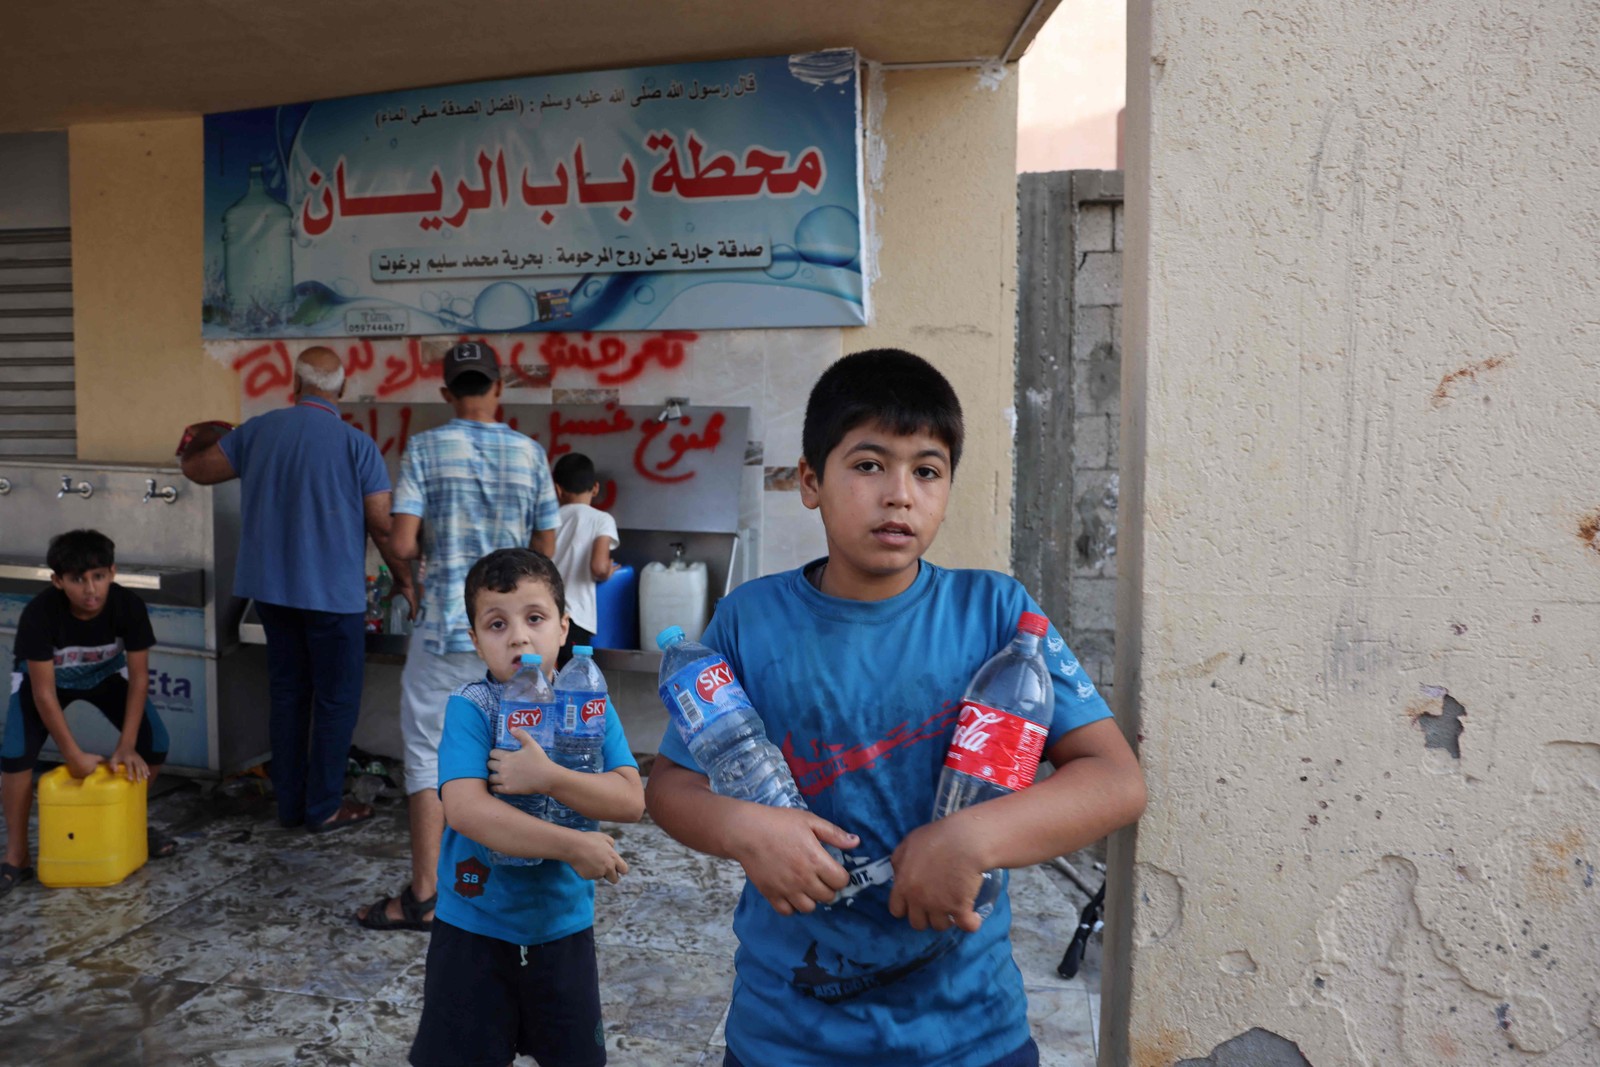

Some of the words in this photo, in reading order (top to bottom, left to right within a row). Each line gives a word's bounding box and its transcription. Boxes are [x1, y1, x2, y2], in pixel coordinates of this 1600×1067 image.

[666, 79, 684, 99] الله
[688, 79, 730, 100] رسول
[734, 73, 757, 96] قال
[575, 88, 603, 108] عليه
[609, 87, 625, 104] الله
[630, 84, 662, 107] صلى
[411, 104, 438, 126] سقي
[441, 98, 482, 116] الصدقة
[646, 132, 822, 199] محطة
[303, 148, 509, 236] الريان
[522, 142, 636, 226] باب
[502, 249, 544, 270] بحرية
[556, 246, 614, 268] المرحومة
[615, 250, 641, 267] روح
[644, 246, 668, 266] عن
[671, 242, 714, 264] جارية
[717, 240, 764, 259] صدقة
[426, 253, 458, 273] سليم
[461, 253, 499, 268] محمد
[699, 666, 733, 691] SKY
[586, 701, 606, 714] SKY
[511, 711, 541, 726] SKY
[462, 872, 479, 884] SB
